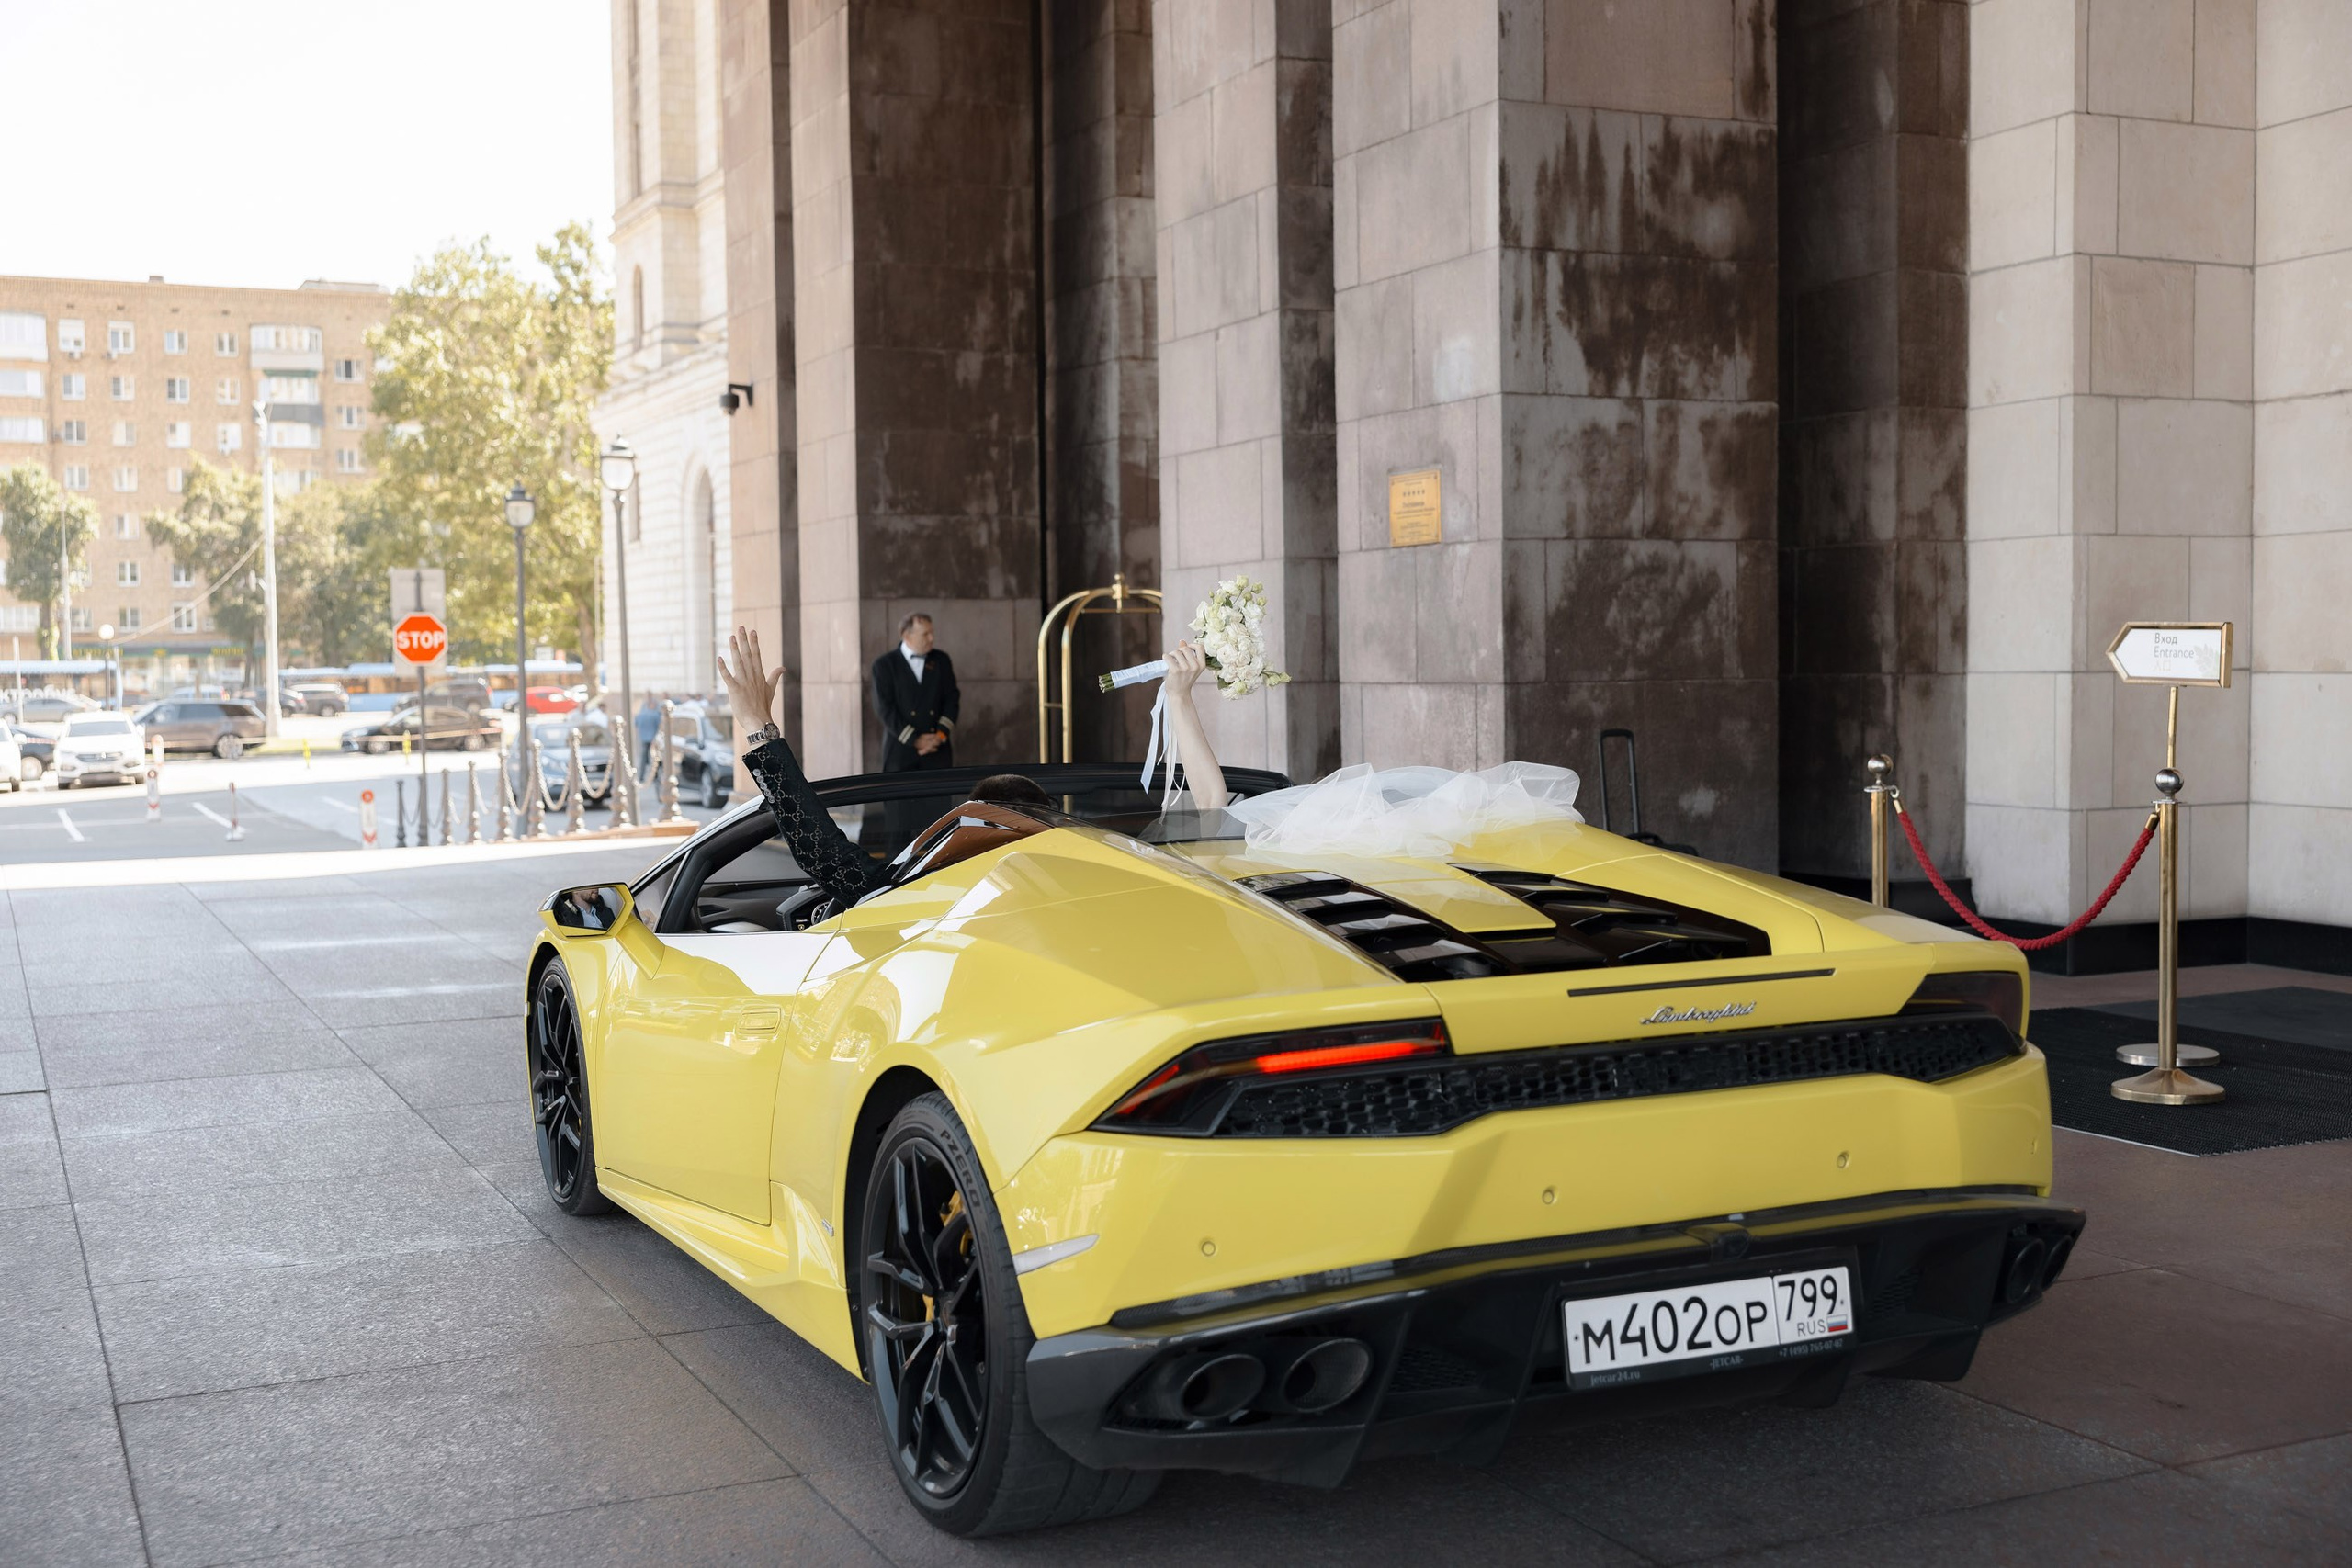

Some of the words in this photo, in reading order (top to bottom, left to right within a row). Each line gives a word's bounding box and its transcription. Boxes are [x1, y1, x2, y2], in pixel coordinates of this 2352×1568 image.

[397, 630, 444, 649] STOP
[2154, 632, 2177, 645] Вход
[2154, 646, 2195, 659] Entrance
[1640, 1001, 1757, 1025] Lamborghini
[1778, 1274, 1838, 1322] 799
[1796, 1319, 1826, 1337] RUS
[1590, 1371, 1641, 1386] jetcar24.ru
